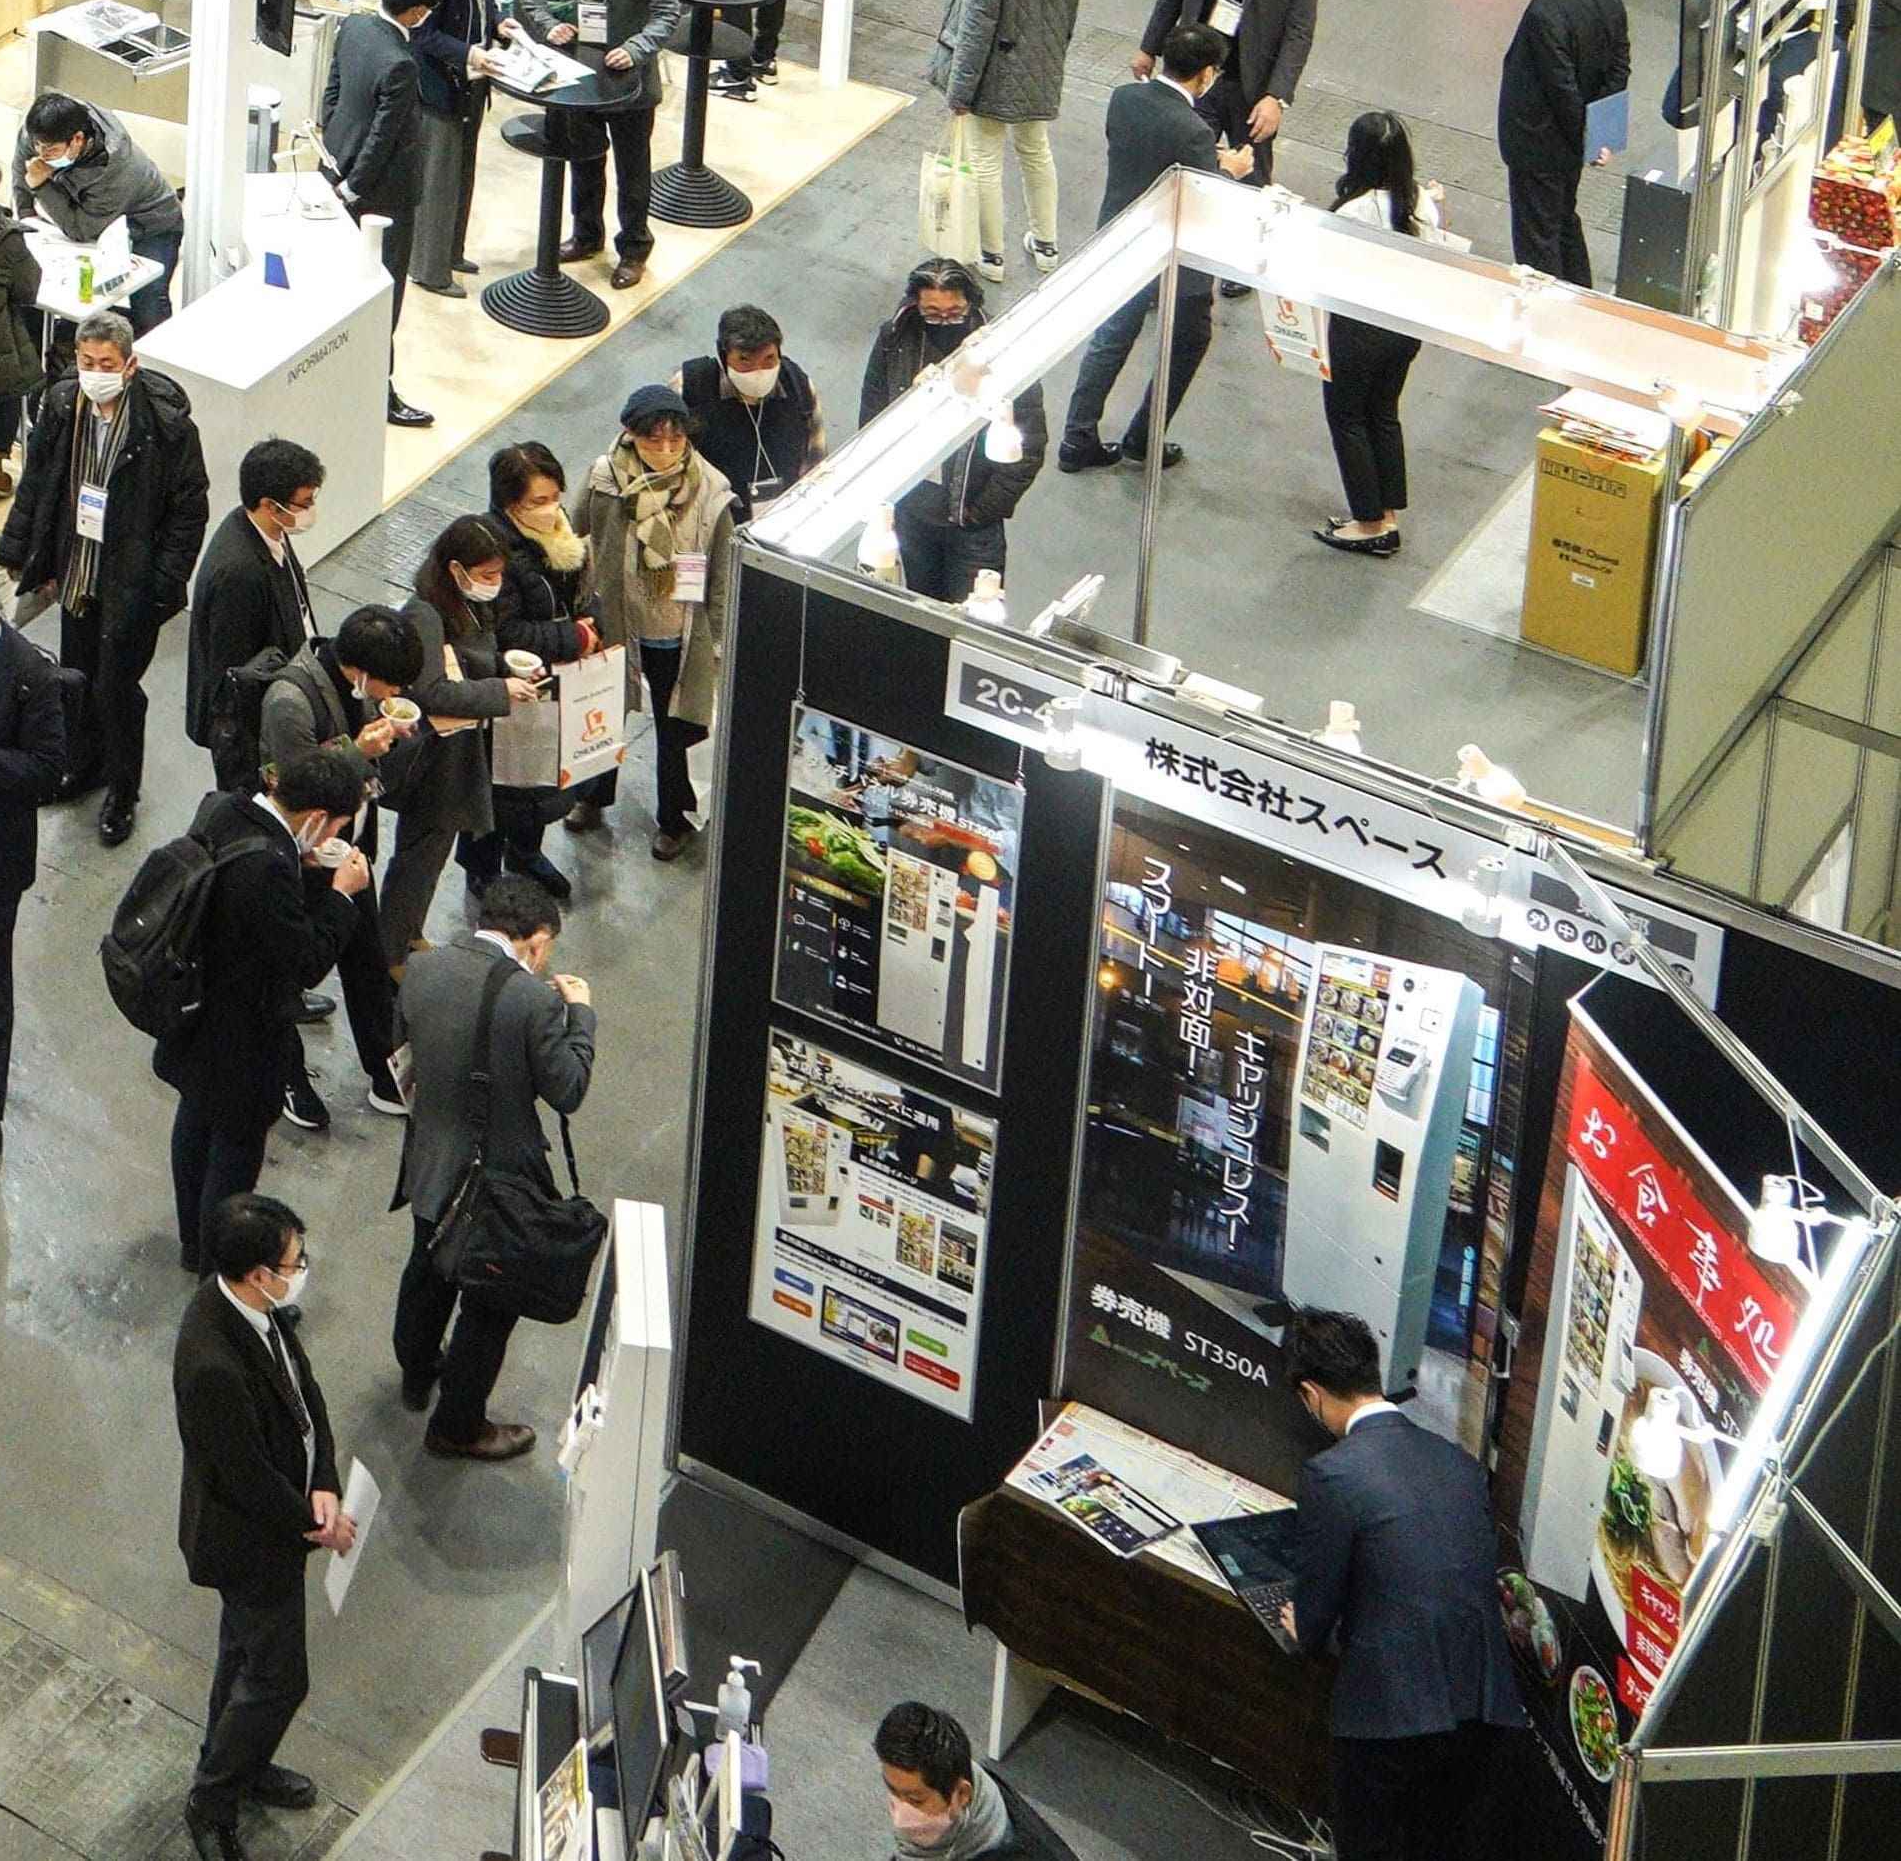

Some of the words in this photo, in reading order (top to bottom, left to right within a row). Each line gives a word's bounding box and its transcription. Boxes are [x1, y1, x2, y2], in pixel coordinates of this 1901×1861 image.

[1143, 736, 1449, 880] 株式会社スペース
[1134, 856, 1174, 1004] スマート!
[1180, 947, 1219, 1078] 非対面!
[1220, 1030, 1272, 1254] キャッシュレス!
[1581, 1105, 1780, 1377] お食事処
[1089, 1282, 1173, 1341] 券売機
[1183, 1331, 1270, 1387] ST350A
